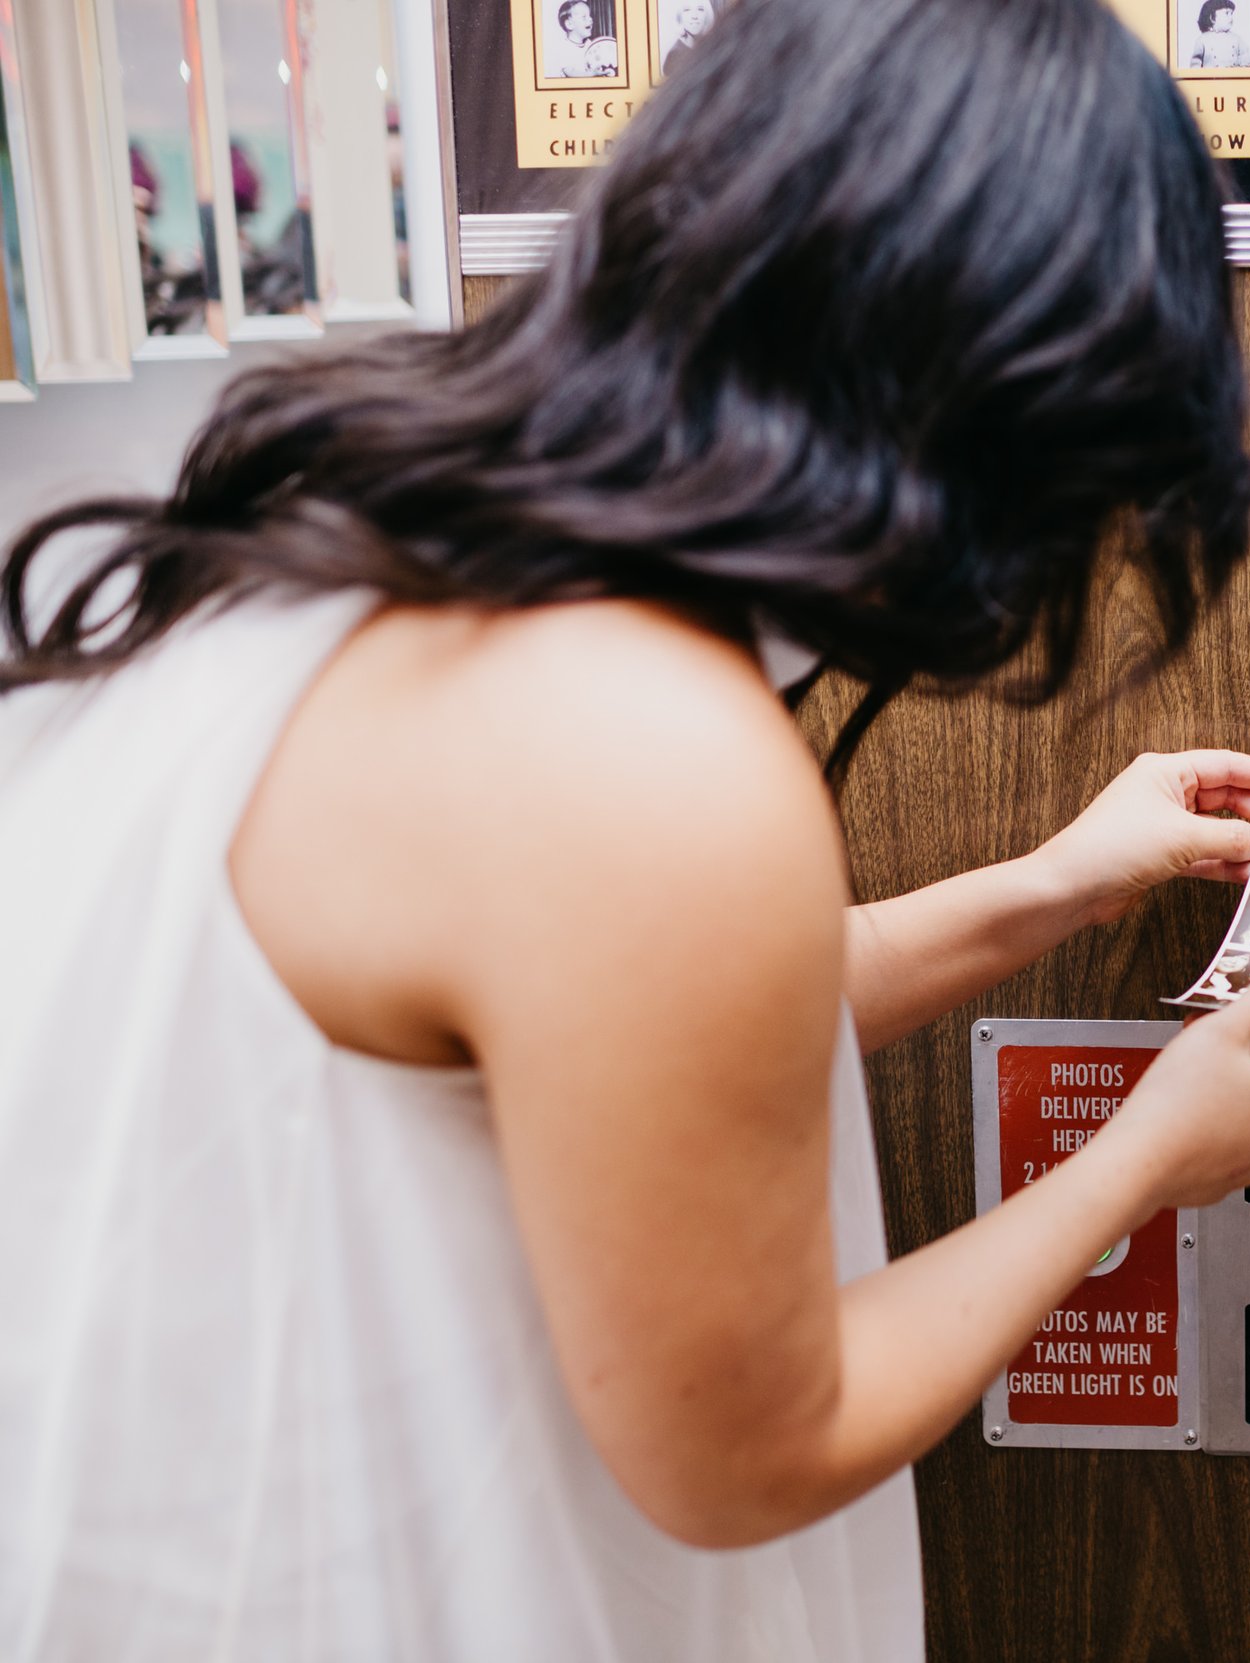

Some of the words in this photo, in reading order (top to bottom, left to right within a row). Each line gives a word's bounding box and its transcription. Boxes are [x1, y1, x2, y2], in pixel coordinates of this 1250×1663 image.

[550, 101, 634, 119] ELECT
[1201, 133, 1246, 150] OW
[1051, 1063, 1125, 1087] PHOTOS
[1041, 1096, 1127, 1120] DELIVERE
[1023, 1161, 1035, 1184] 2
[1037, 1310, 1089, 1333] OTOS
[1096, 1311, 1138, 1333] MAY
[1146, 1312, 1167, 1334] BE
[1033, 1342, 1092, 1364] TAKEN
[1099, 1342, 1152, 1365] WHEN
[1009, 1372, 1064, 1395] GREEN
[1071, 1373, 1122, 1395] LIGHT
[1130, 1374, 1146, 1396] IS
[1153, 1375, 1178, 1397] ON
